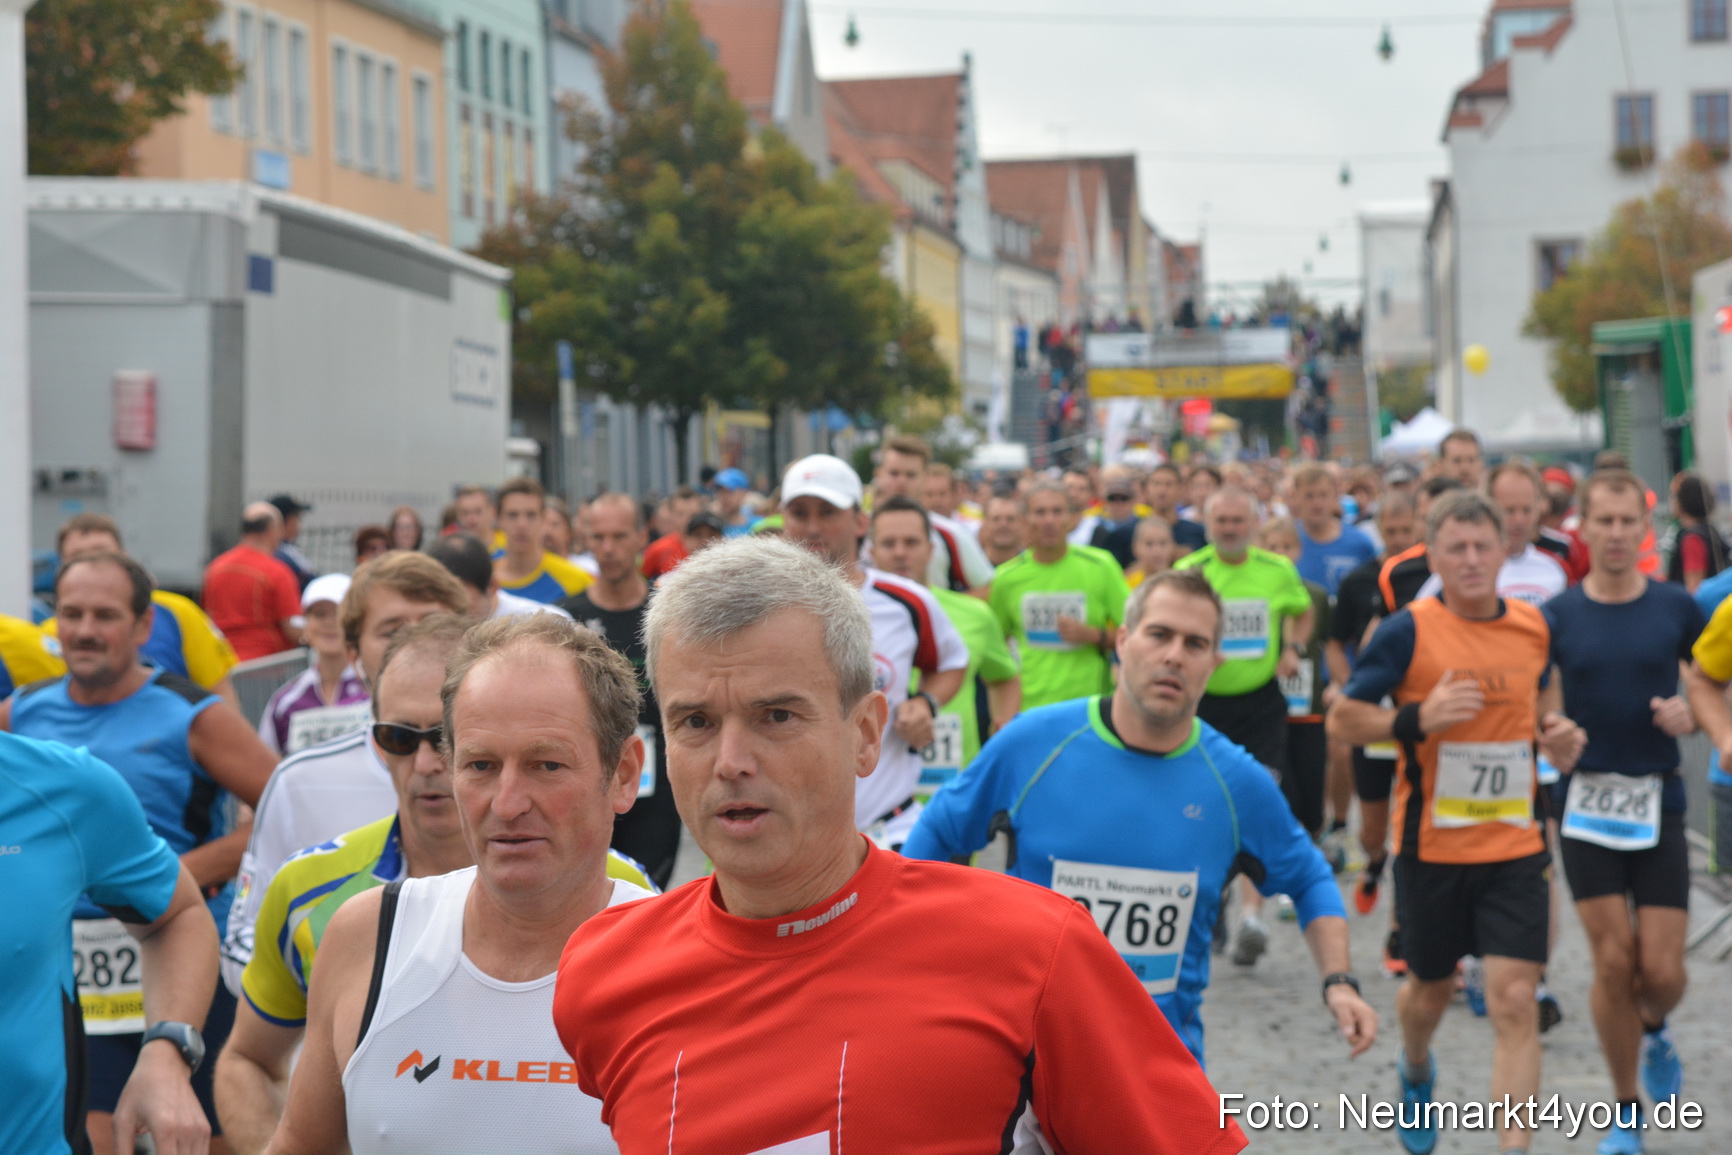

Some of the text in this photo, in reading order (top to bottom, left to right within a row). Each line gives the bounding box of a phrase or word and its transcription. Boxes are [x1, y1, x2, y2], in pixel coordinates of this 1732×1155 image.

[1471, 763, 1509, 796] 70
[1056, 873, 1173, 896] PARTL Neumarkt
[1071, 895, 1179, 948] 768
